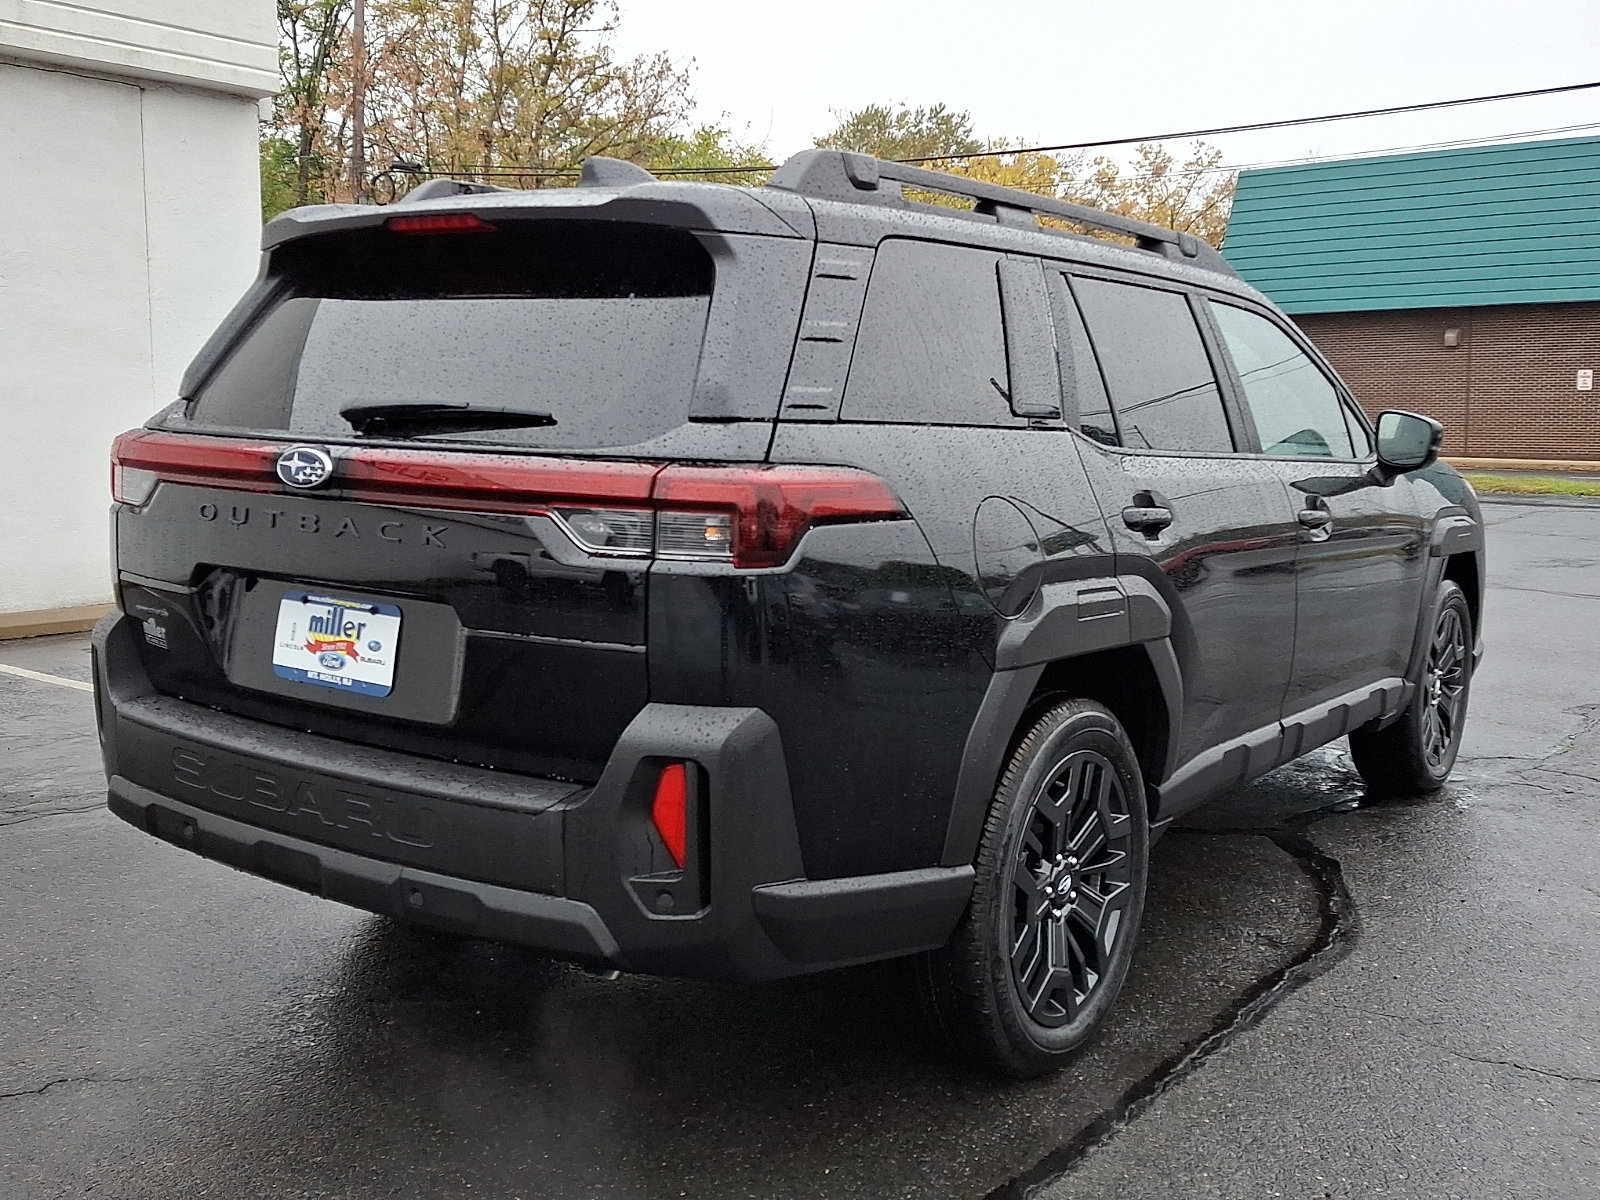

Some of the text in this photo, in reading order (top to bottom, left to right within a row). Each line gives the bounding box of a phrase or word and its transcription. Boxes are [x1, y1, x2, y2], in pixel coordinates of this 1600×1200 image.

[200, 503, 449, 548] OUTBACK
[309, 607, 367, 640] miller
[280, 642, 304, 651] LINCOLN
[322, 654, 343, 668] Ford
[360, 656, 386, 666] SUBARU
[172, 746, 435, 848] SUBARU
